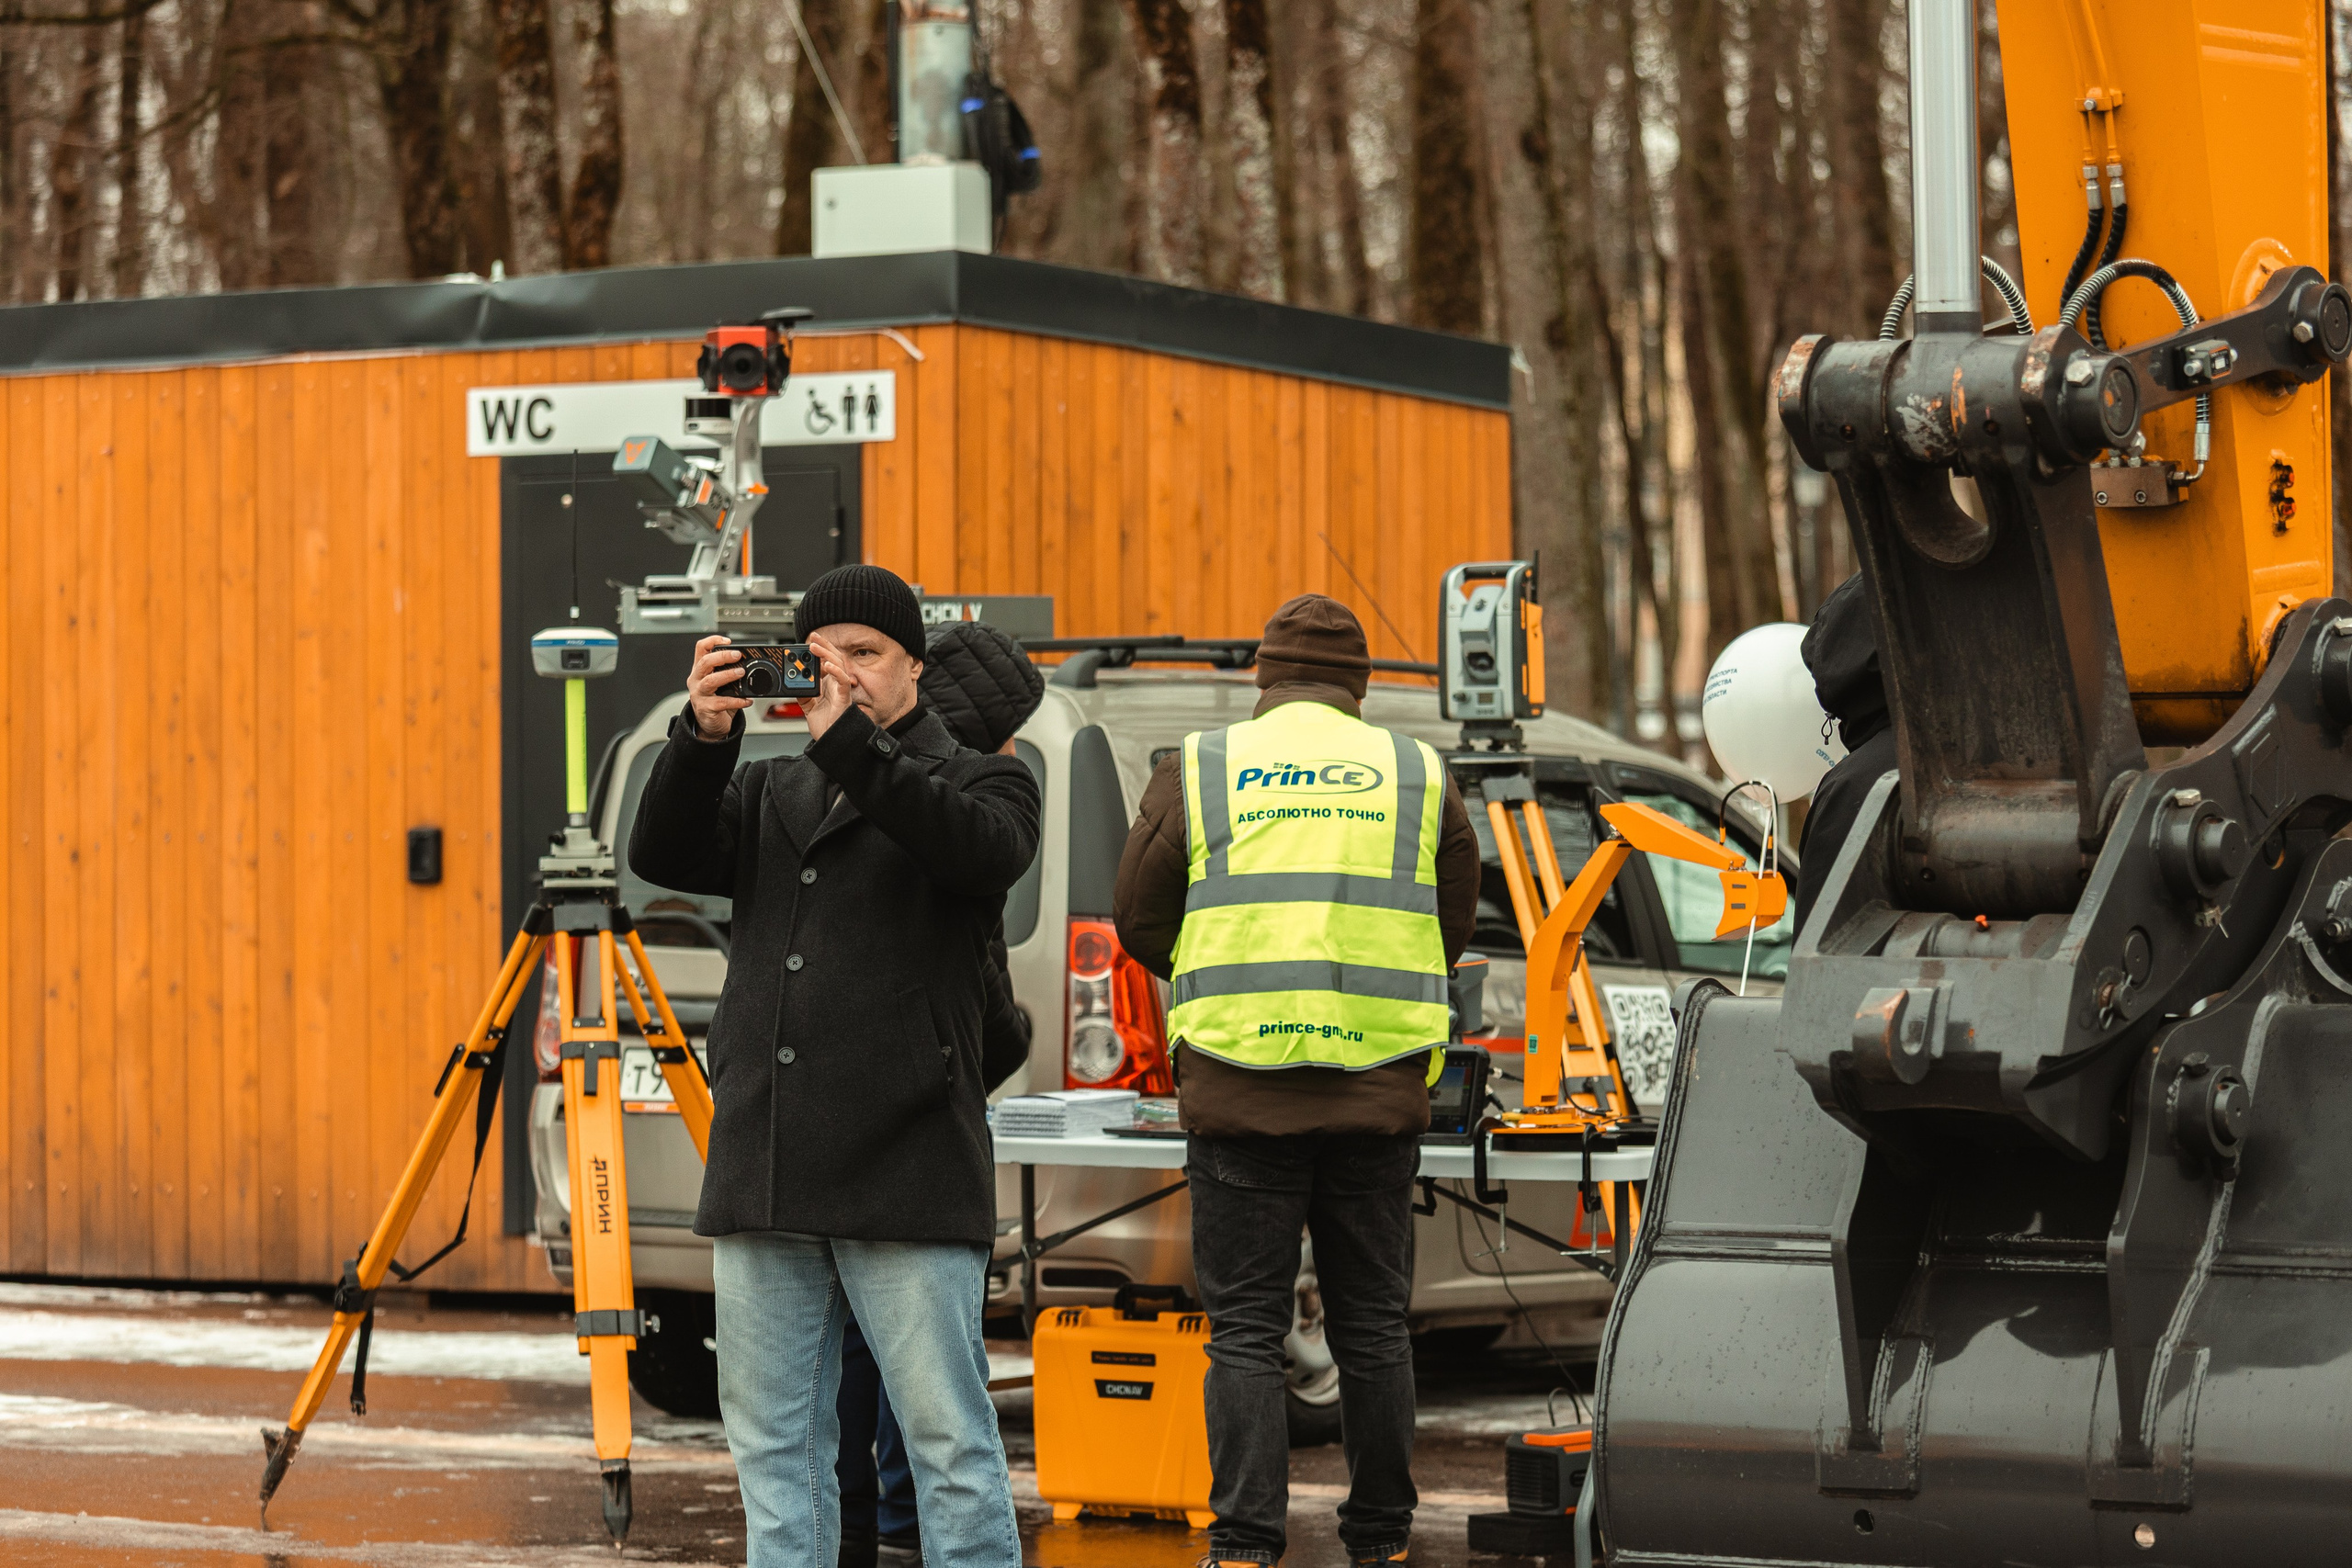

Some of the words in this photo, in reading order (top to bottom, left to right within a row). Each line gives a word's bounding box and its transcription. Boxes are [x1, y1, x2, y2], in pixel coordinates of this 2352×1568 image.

[481, 397, 553, 440] WC
[1238, 807, 1331, 824] АБСОЛЮТНО
[1336, 808, 1385, 822] ТОЧНО
